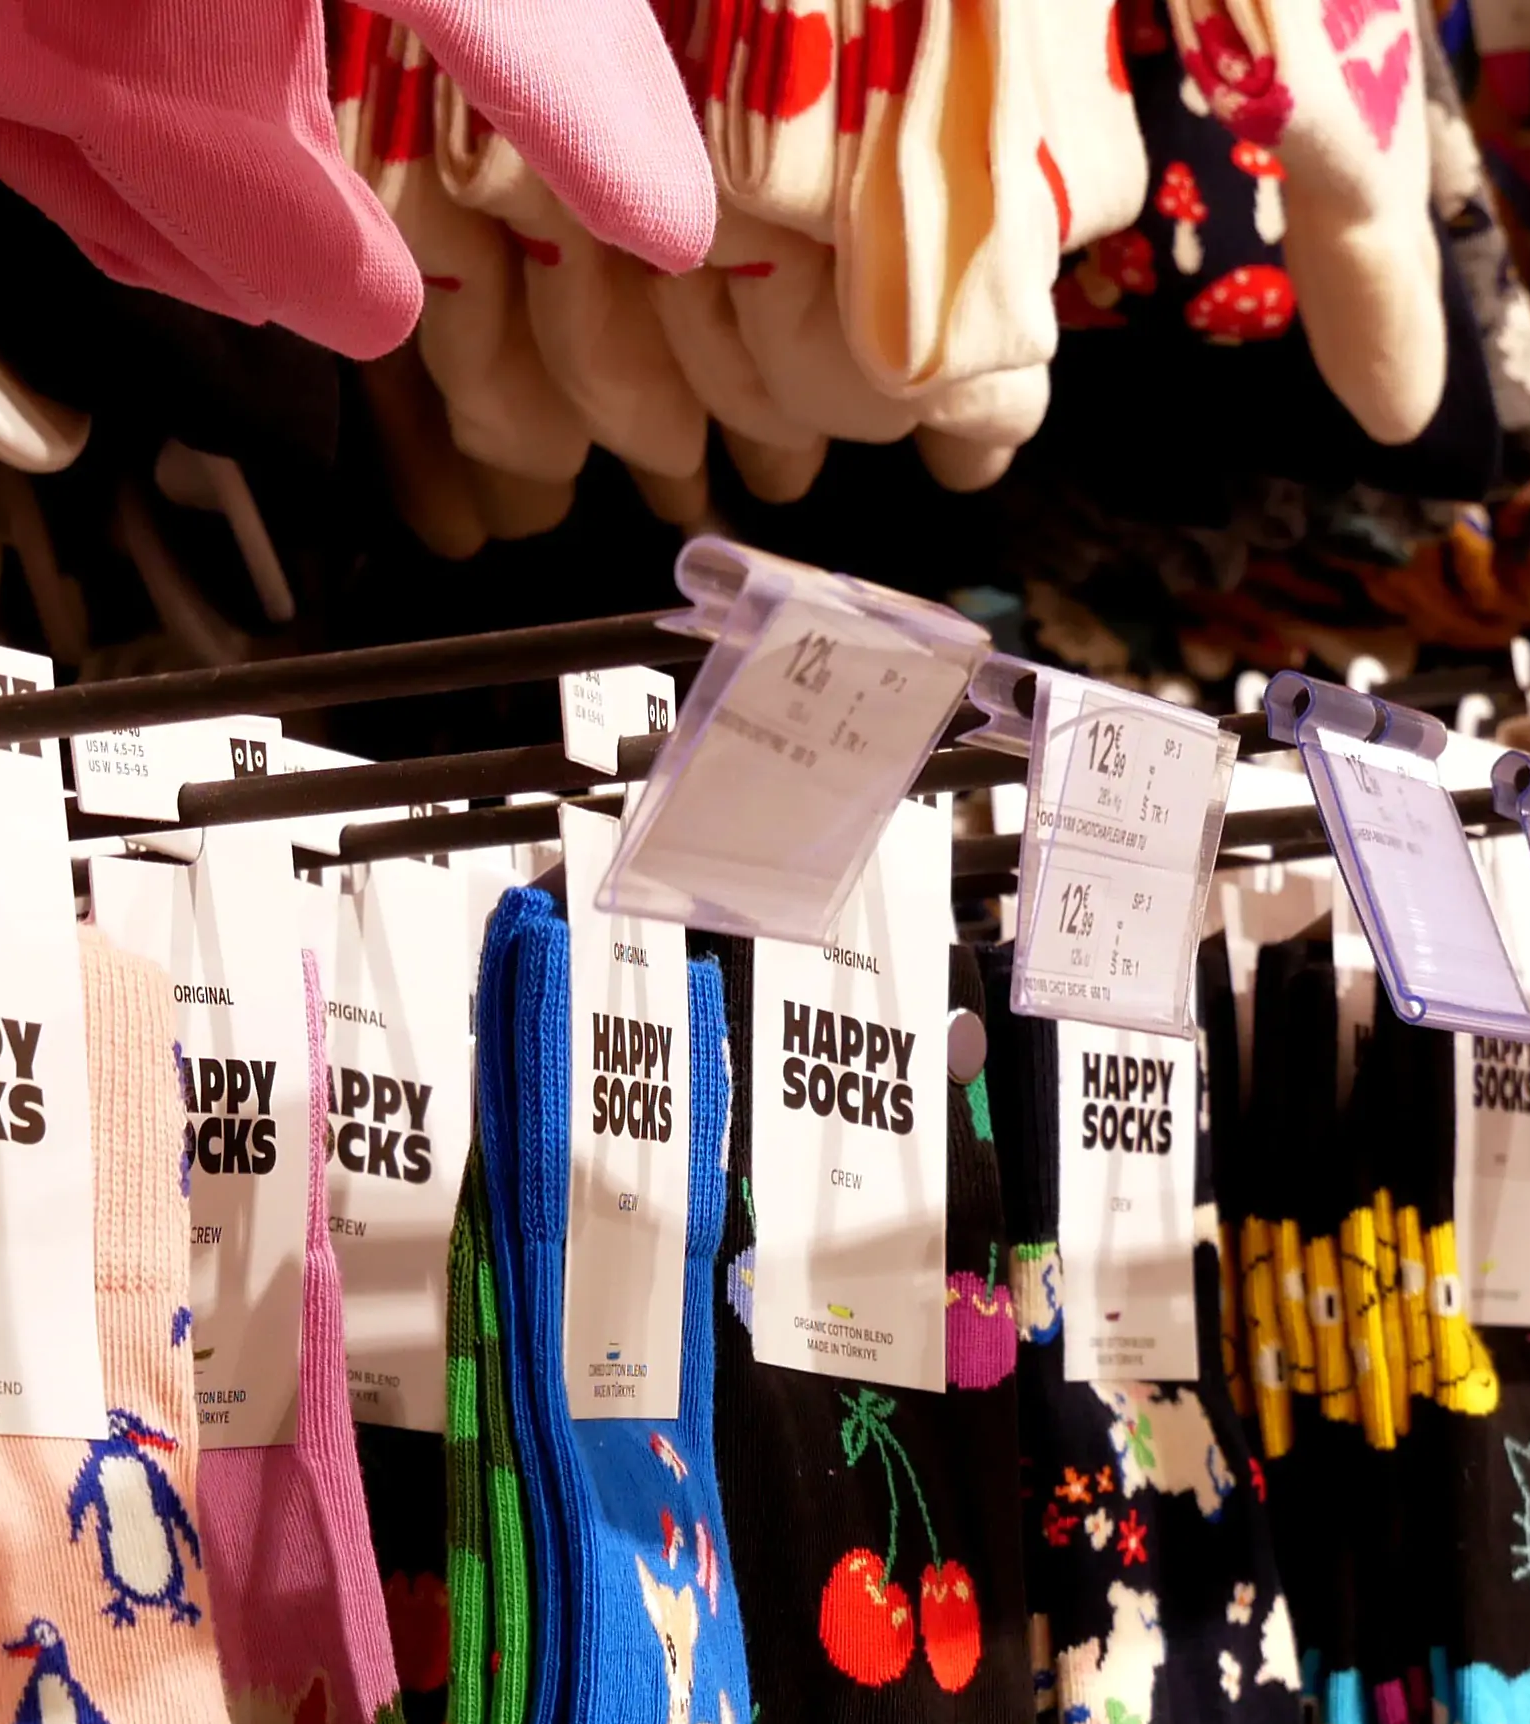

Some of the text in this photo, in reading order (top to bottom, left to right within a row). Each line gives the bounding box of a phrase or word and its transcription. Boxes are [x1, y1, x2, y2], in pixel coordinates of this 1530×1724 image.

[86, 740, 97, 753] US
[99, 741, 109, 754] M
[88, 761, 100, 773] US
[102, 762, 112, 774] W
[614, 942, 649, 968] ORIGINAL
[823, 946, 880, 975] ORIGINAL
[174, 985, 234, 1006] ORIGINAL
[593, 1012, 672, 1082] HAPPY
[783, 1000, 916, 1081] HAPPY
[182, 1057, 277, 1116] APPY
[1082, 1052, 1174, 1106] HAPPY
[593, 1075, 672, 1143] SOCKS
[783, 1057, 914, 1135] SOCKS
[1082, 1103, 1173, 1155] SOCKS
[831, 1169, 862, 1190] CREW
[618, 1193, 638, 1211] CREW
[794, 1317, 893, 1345] ORGANIC COTTON BLEND
[807, 1339, 830, 1354] MADE
[831, 1342, 842, 1356] IN
[217, 1390, 246, 1404] BLEND
